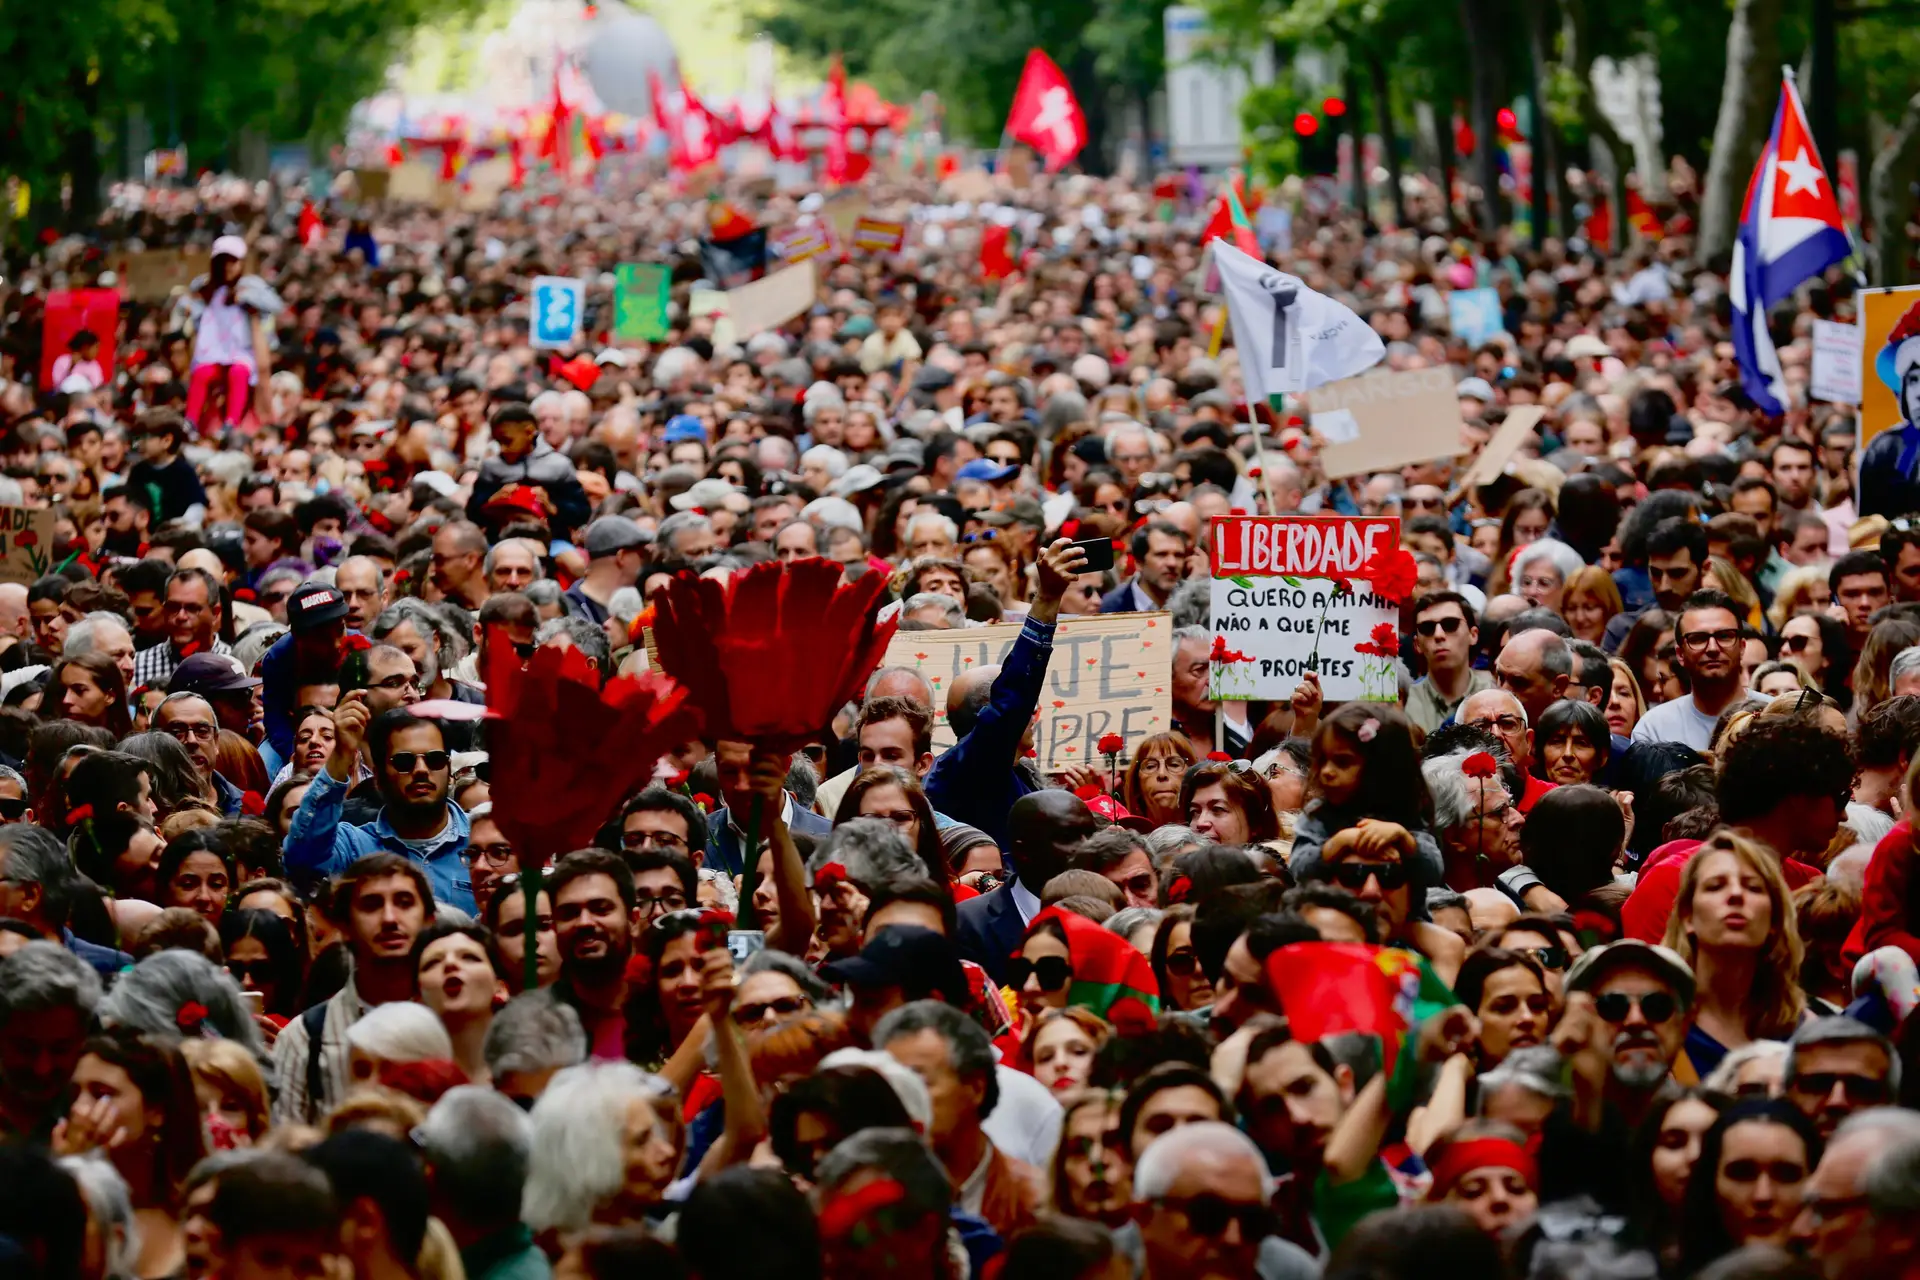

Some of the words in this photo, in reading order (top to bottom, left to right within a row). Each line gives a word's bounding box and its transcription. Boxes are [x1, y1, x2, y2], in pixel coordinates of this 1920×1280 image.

[1309, 367, 1452, 410] MANGO
[0, 507, 38, 530] ADE
[1216, 520, 1390, 573] LIBERDADE
[300, 591, 333, 610] MARVEL
[1227, 588, 1306, 608] QUERO
[1312, 591, 1326, 608] A
[1216, 613, 1250, 632] NÃO
[1259, 618, 1269, 630] A
[1277, 617, 1315, 634] QUE
[1324, 619, 1350, 636] ME
[952, 633, 1142, 700] JE
[1260, 658, 1354, 678] PROMTES
